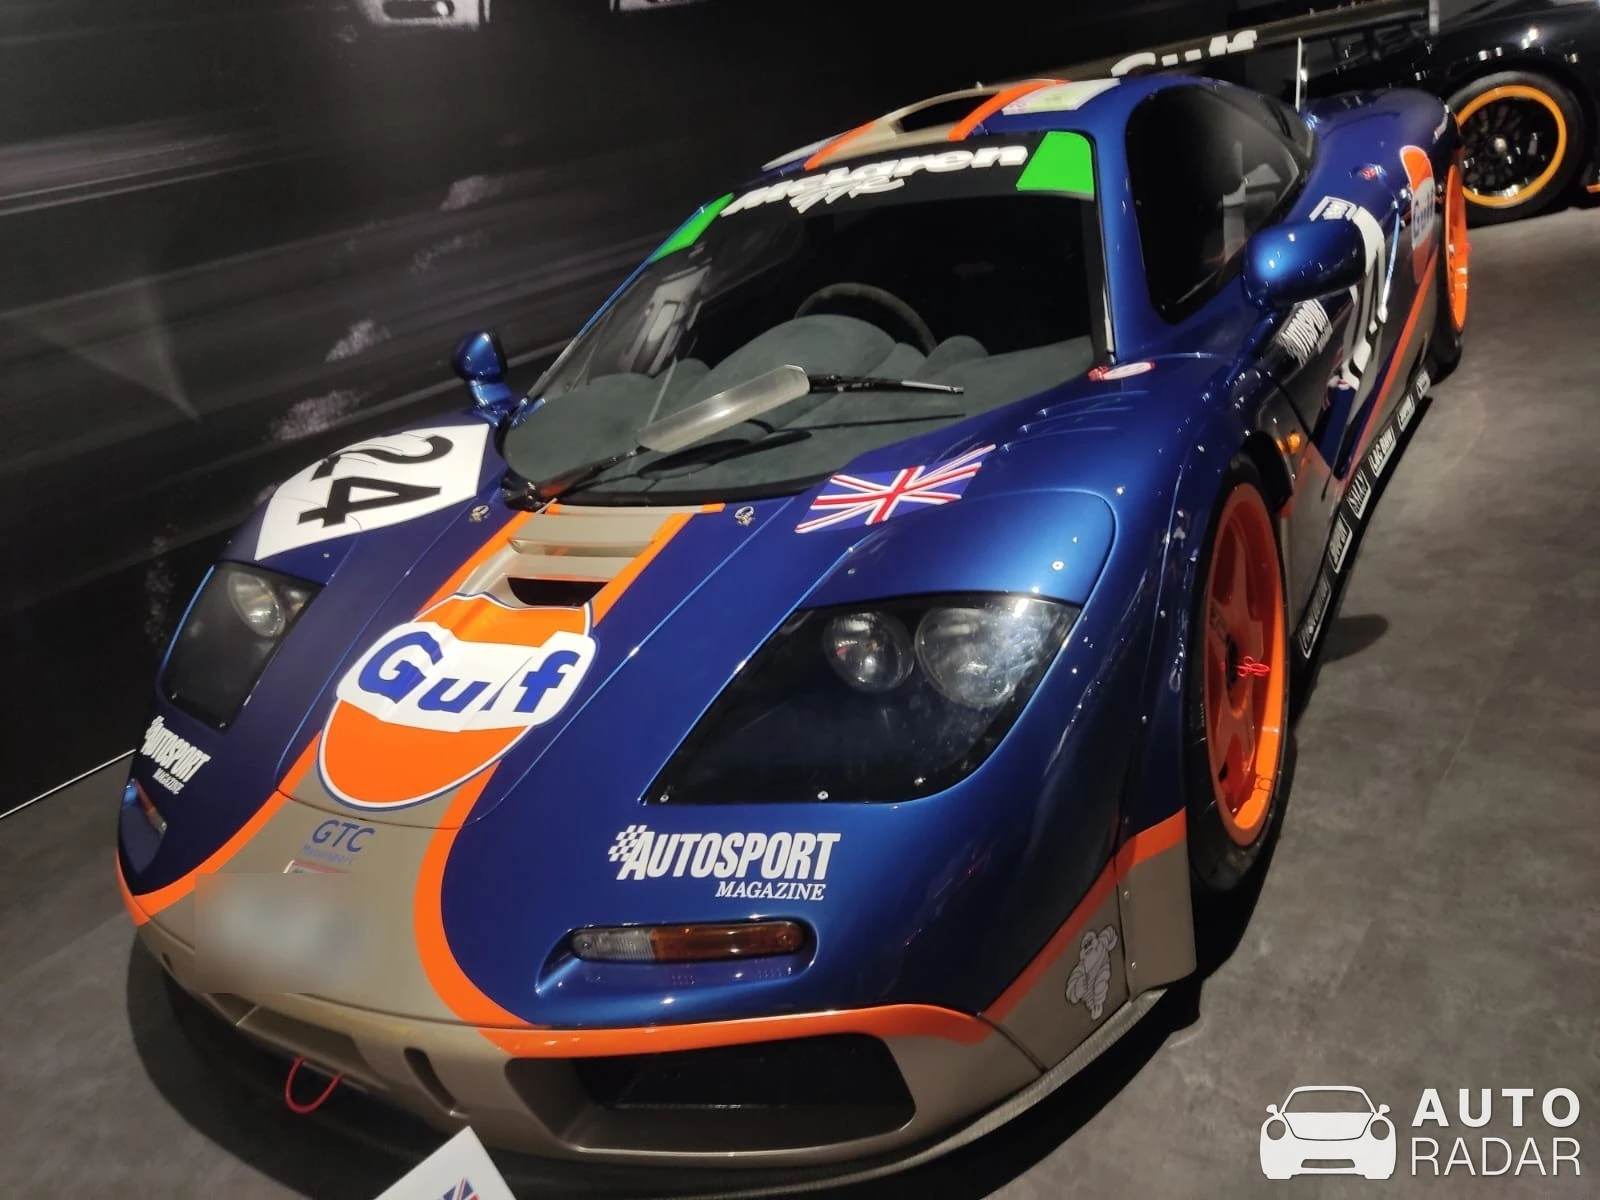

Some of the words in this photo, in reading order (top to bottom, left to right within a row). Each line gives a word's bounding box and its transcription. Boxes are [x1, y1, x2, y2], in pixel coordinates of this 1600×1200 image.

[298, 435, 453, 528] 24
[312, 819, 376, 853] GTC
[616, 831, 841, 880] AUTOSPORT
[715, 881, 826, 901] MAGAZINE
